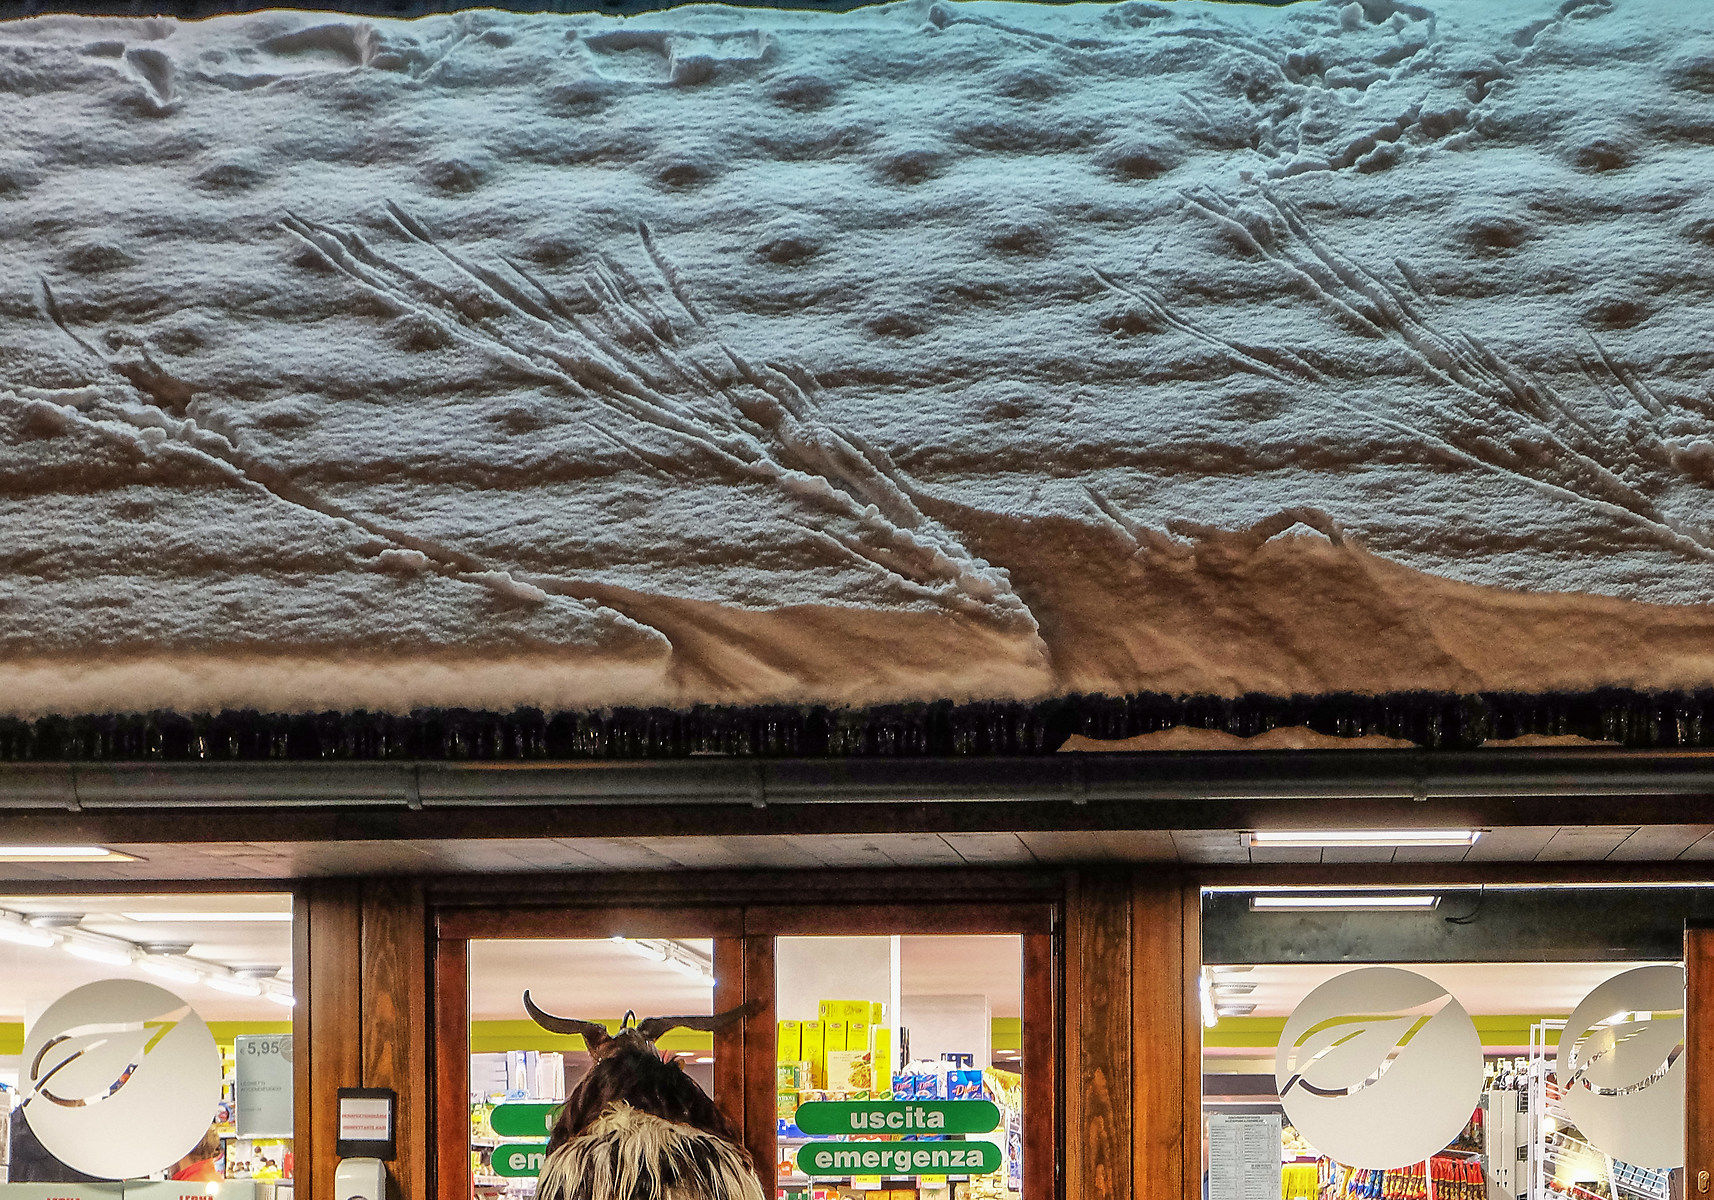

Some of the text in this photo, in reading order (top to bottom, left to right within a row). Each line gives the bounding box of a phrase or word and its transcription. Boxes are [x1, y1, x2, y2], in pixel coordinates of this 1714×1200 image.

[248, 1042, 279, 1056] 5,95
[850, 1106, 944, 1129] uscita
[815, 1149, 983, 1172] emergenza
